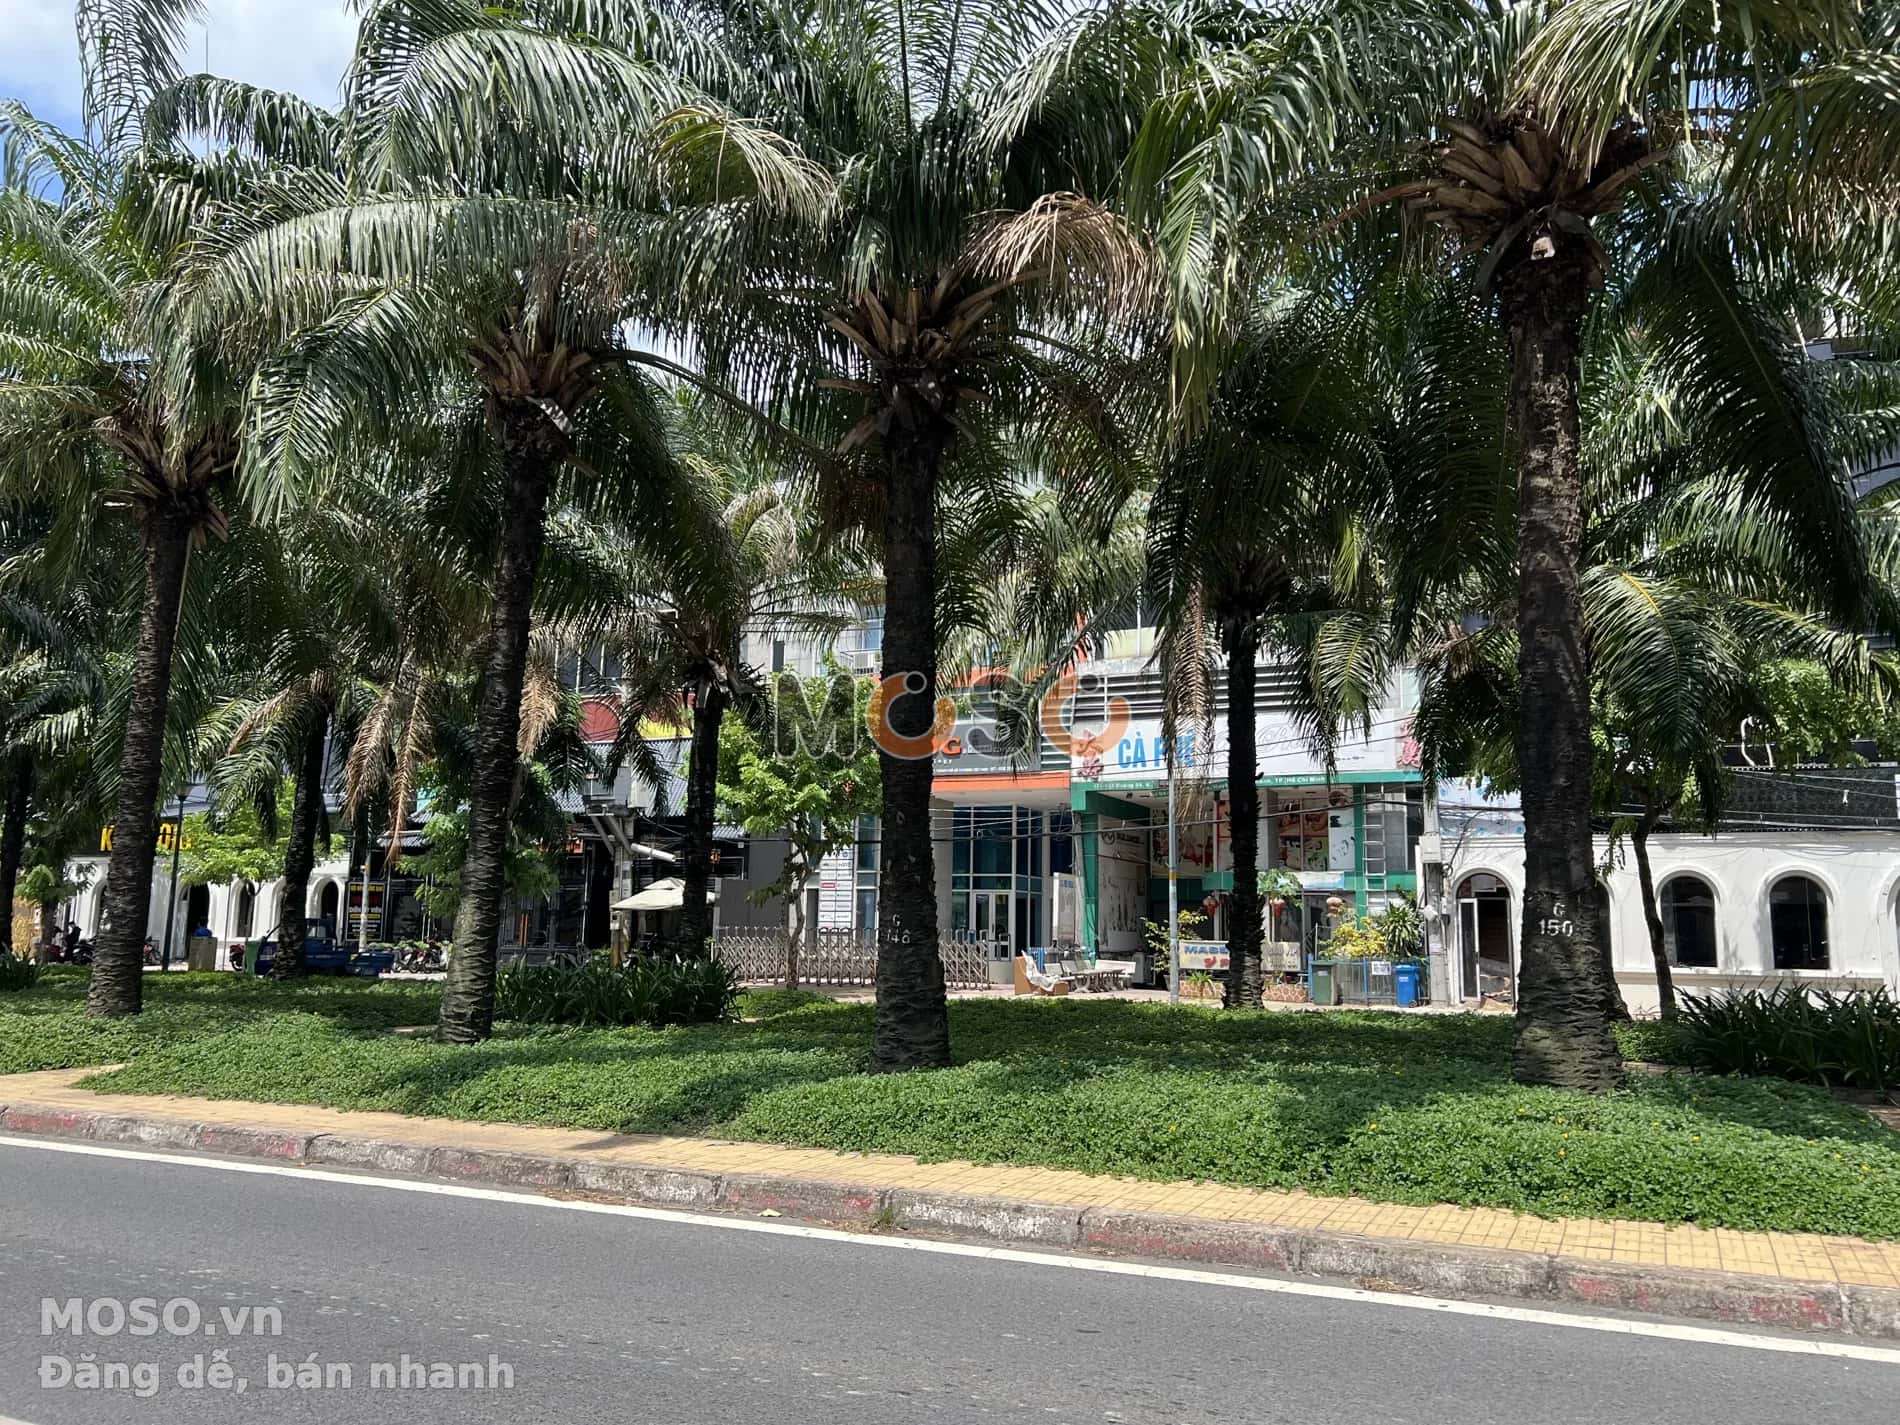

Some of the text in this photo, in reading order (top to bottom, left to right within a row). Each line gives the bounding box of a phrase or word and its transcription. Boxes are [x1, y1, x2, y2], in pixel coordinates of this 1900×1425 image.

[1118, 732, 1146, 768] CÀ
[1553, 902, 1566, 917] G
[1539, 918, 1573, 937] 150
